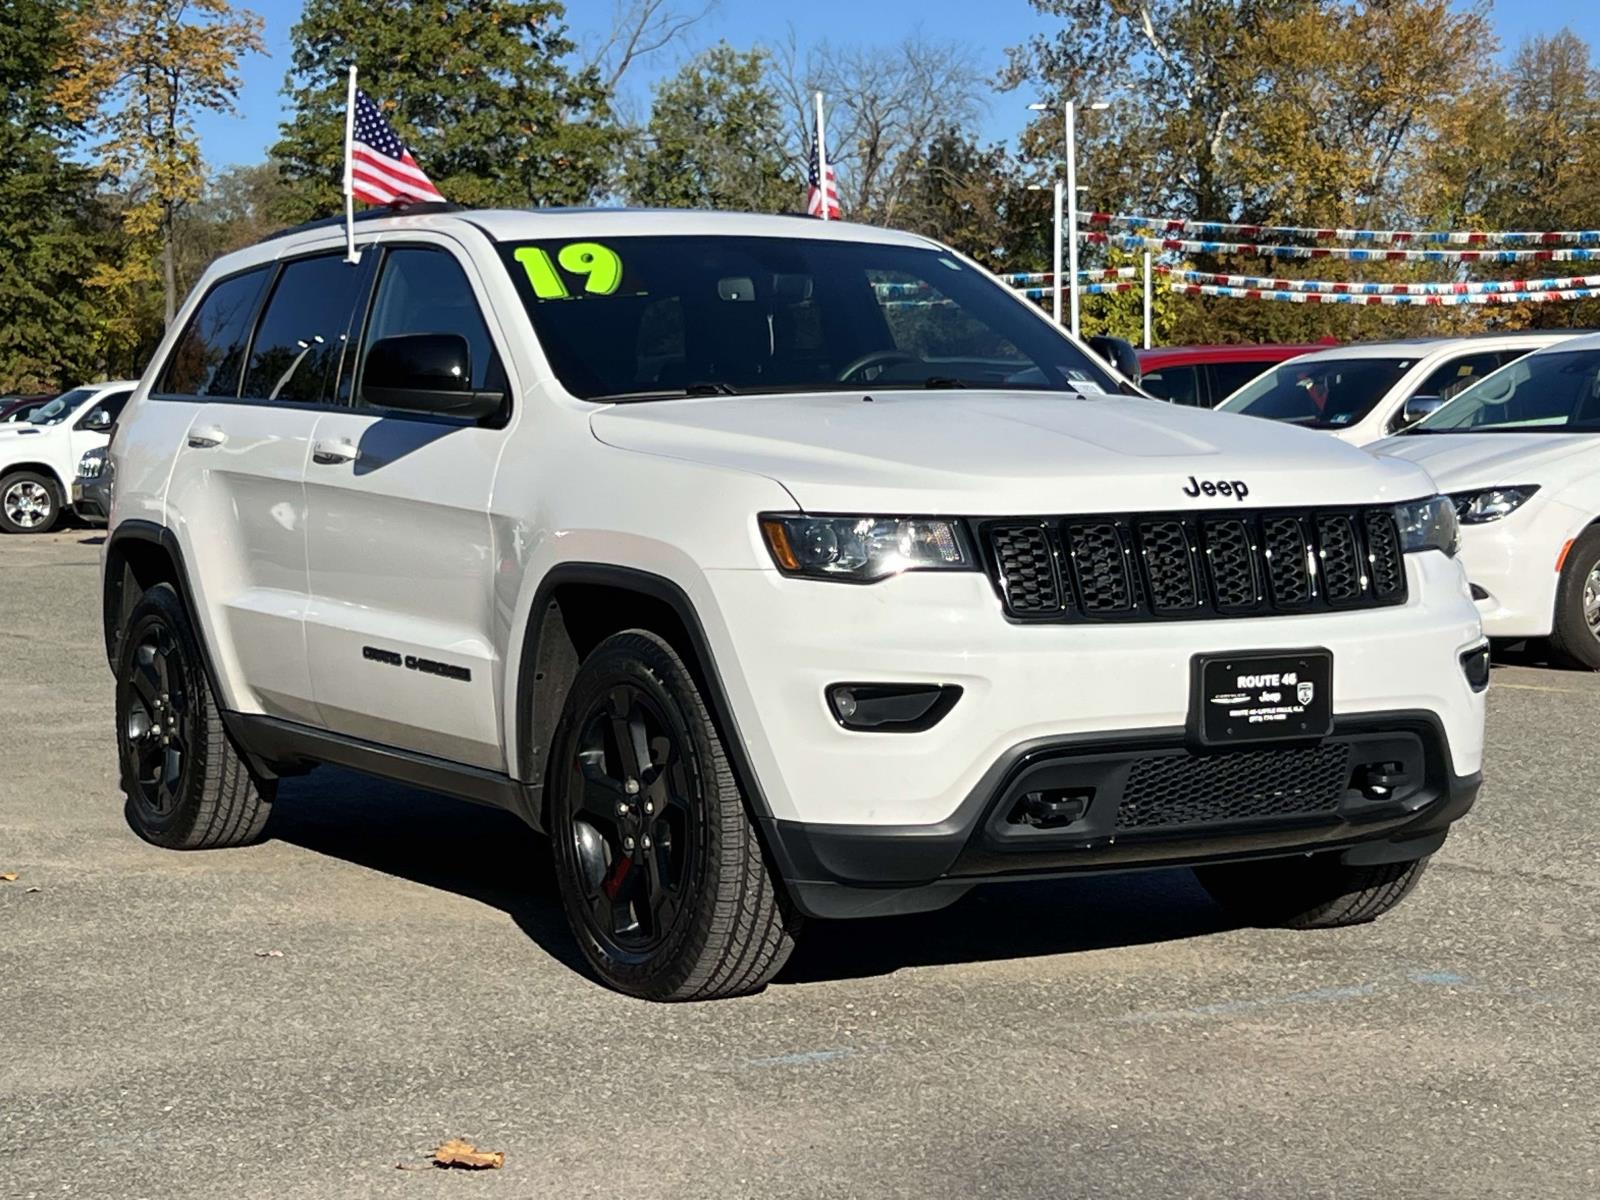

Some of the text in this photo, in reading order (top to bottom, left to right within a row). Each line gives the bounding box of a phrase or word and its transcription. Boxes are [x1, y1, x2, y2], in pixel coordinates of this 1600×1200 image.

[514, 242, 623, 299] 19
[1182, 476, 1249, 502] Jeep
[1237, 673, 1280, 688] ROUTE
[1258, 691, 1282, 703] Jeep
